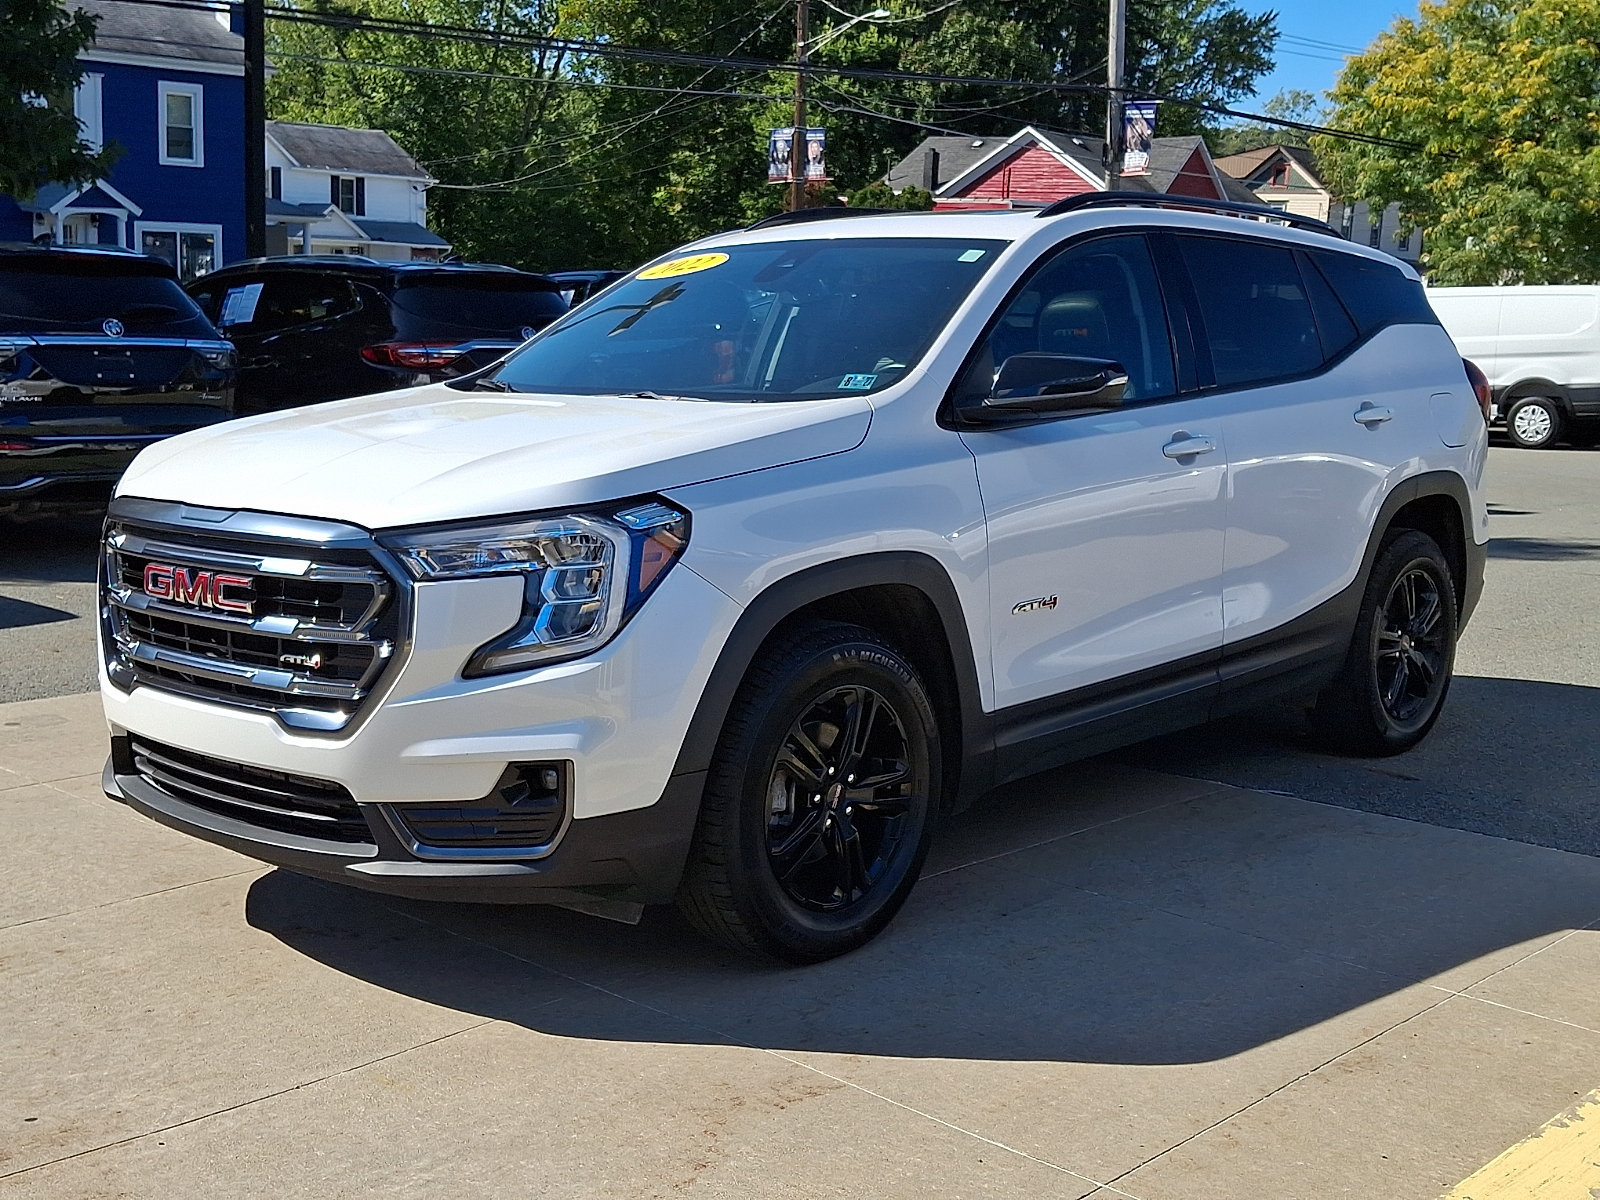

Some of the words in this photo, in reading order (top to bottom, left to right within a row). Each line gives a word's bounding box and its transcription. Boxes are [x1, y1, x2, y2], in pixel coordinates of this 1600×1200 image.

[843, 376, 853, 387] 8
[143, 562, 254, 614] GMC
[1011, 593, 1059, 615] AT4
[279, 653, 321, 669] AT4
[860, 650, 911, 682] MICHELIN
